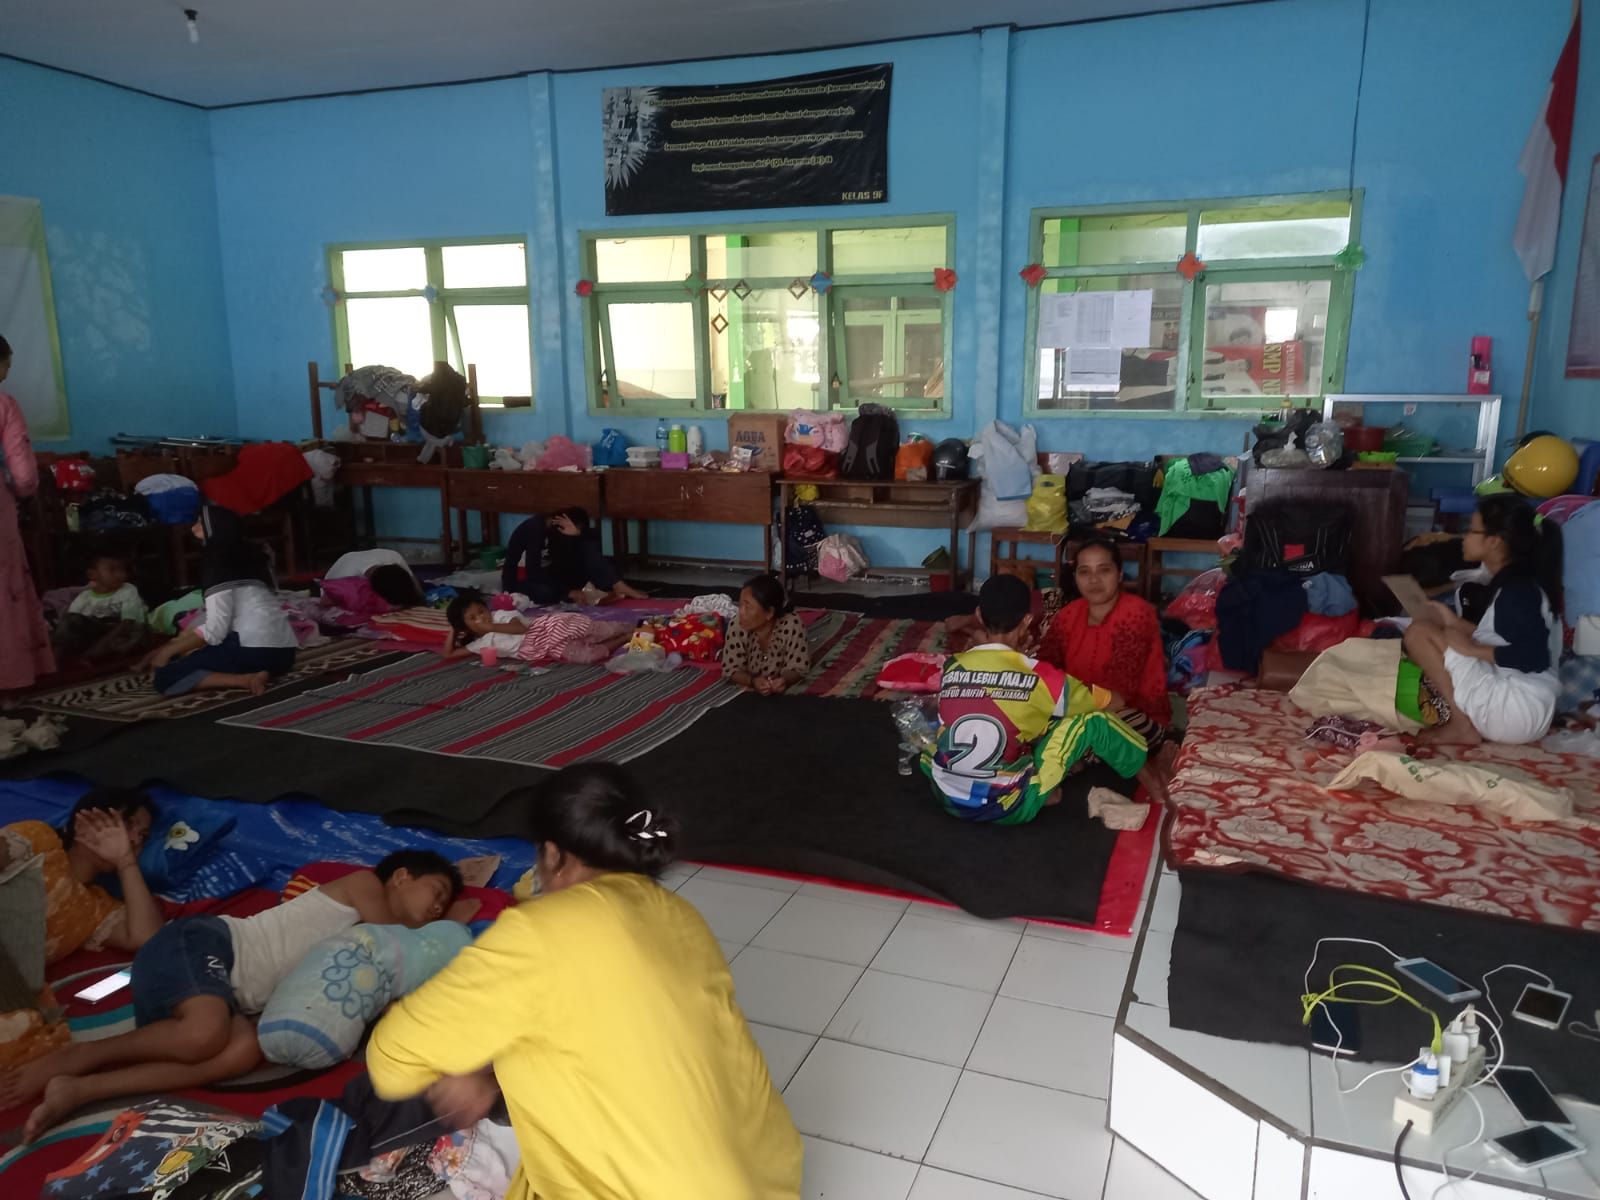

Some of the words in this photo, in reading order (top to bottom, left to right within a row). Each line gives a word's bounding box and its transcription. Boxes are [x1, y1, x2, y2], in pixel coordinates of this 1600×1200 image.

[842, 191, 870, 201] KELAS
[1263, 344, 1281, 374] SMP
[735, 430, 766, 443] AQUA
[971, 672, 998, 686] LEBIH
[998, 671, 1036, 690] MAJU
[944, 714, 1007, 778] 2
